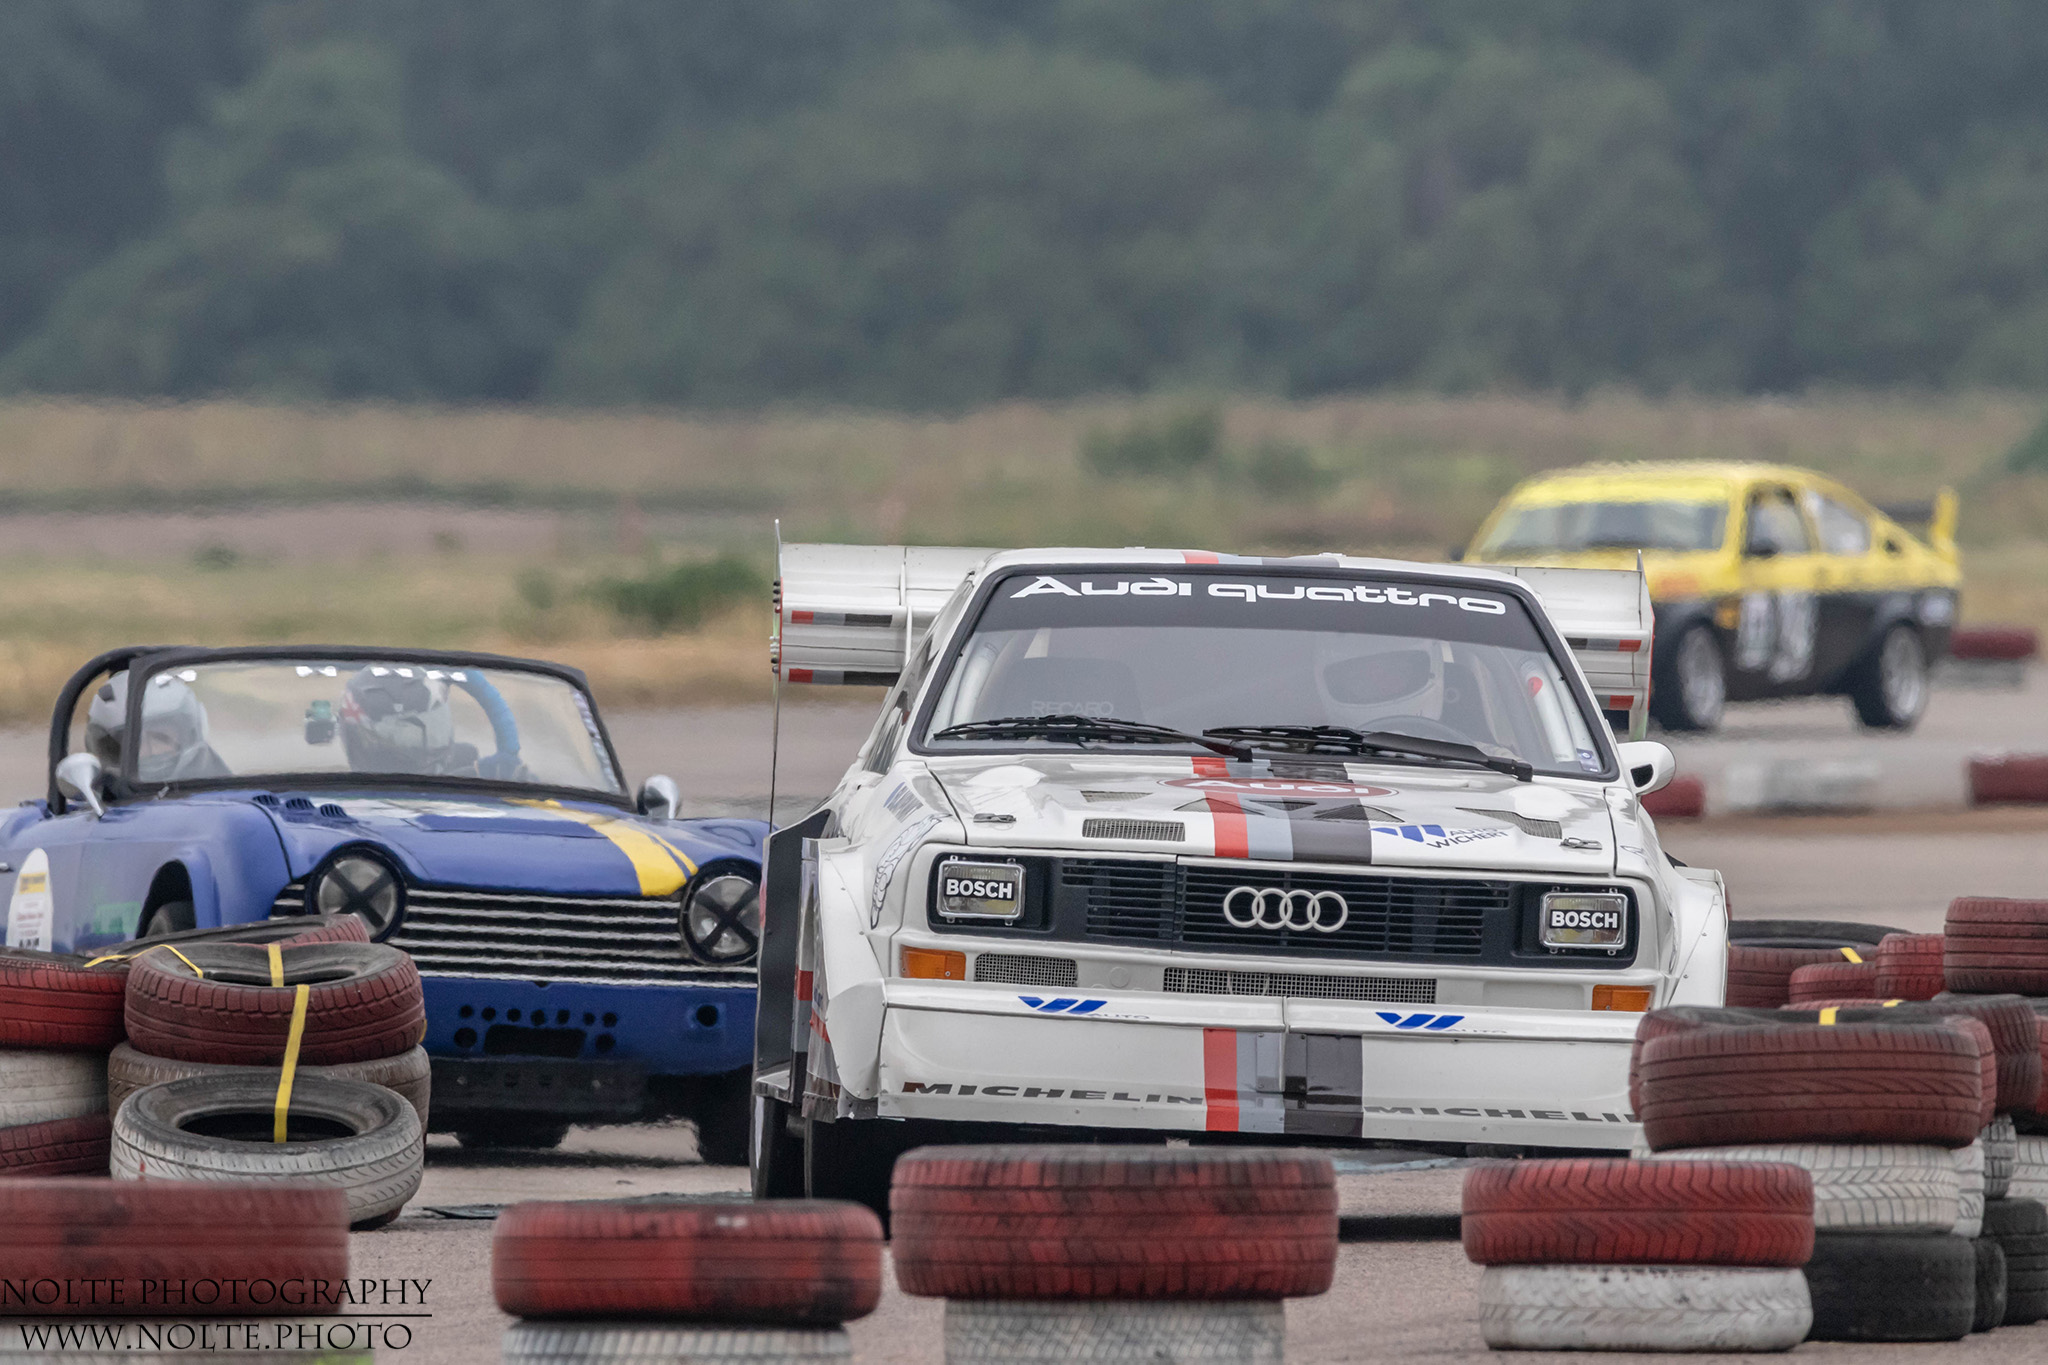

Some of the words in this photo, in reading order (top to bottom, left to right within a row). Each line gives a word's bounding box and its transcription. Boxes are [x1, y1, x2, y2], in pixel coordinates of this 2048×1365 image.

[1010, 575, 1192, 599] Audi
[1207, 583, 1507, 615] quattro
[1185, 779, 1369, 795] Audi
[1426, 830, 1508, 849] WICHERT
[946, 878, 1013, 899] BOSCH
[1551, 910, 1618, 929] BOSCH
[902, 1081, 1204, 1105] MICHELIN
